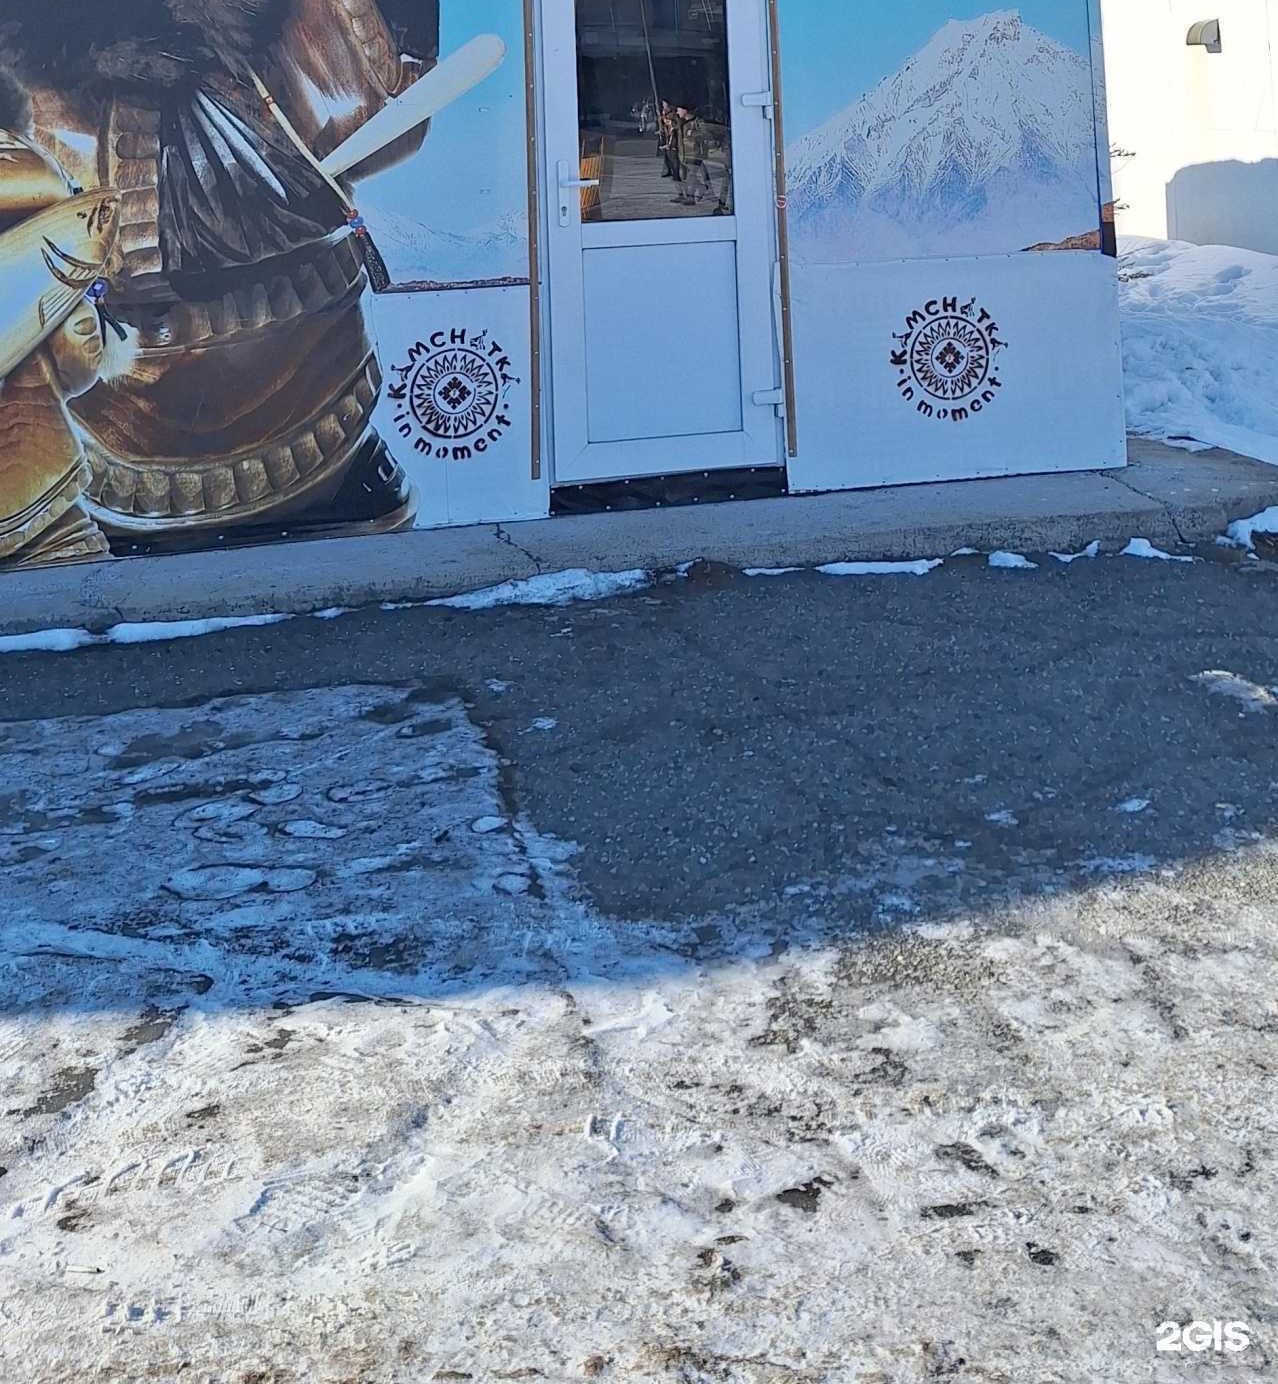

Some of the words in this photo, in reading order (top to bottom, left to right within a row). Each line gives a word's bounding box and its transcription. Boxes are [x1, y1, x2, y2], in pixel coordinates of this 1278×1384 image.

[897, 375, 915, 402] in
[916, 375, 1002, 423] moment
[393, 410, 412, 439] in
[413, 414, 512, 461] moment
